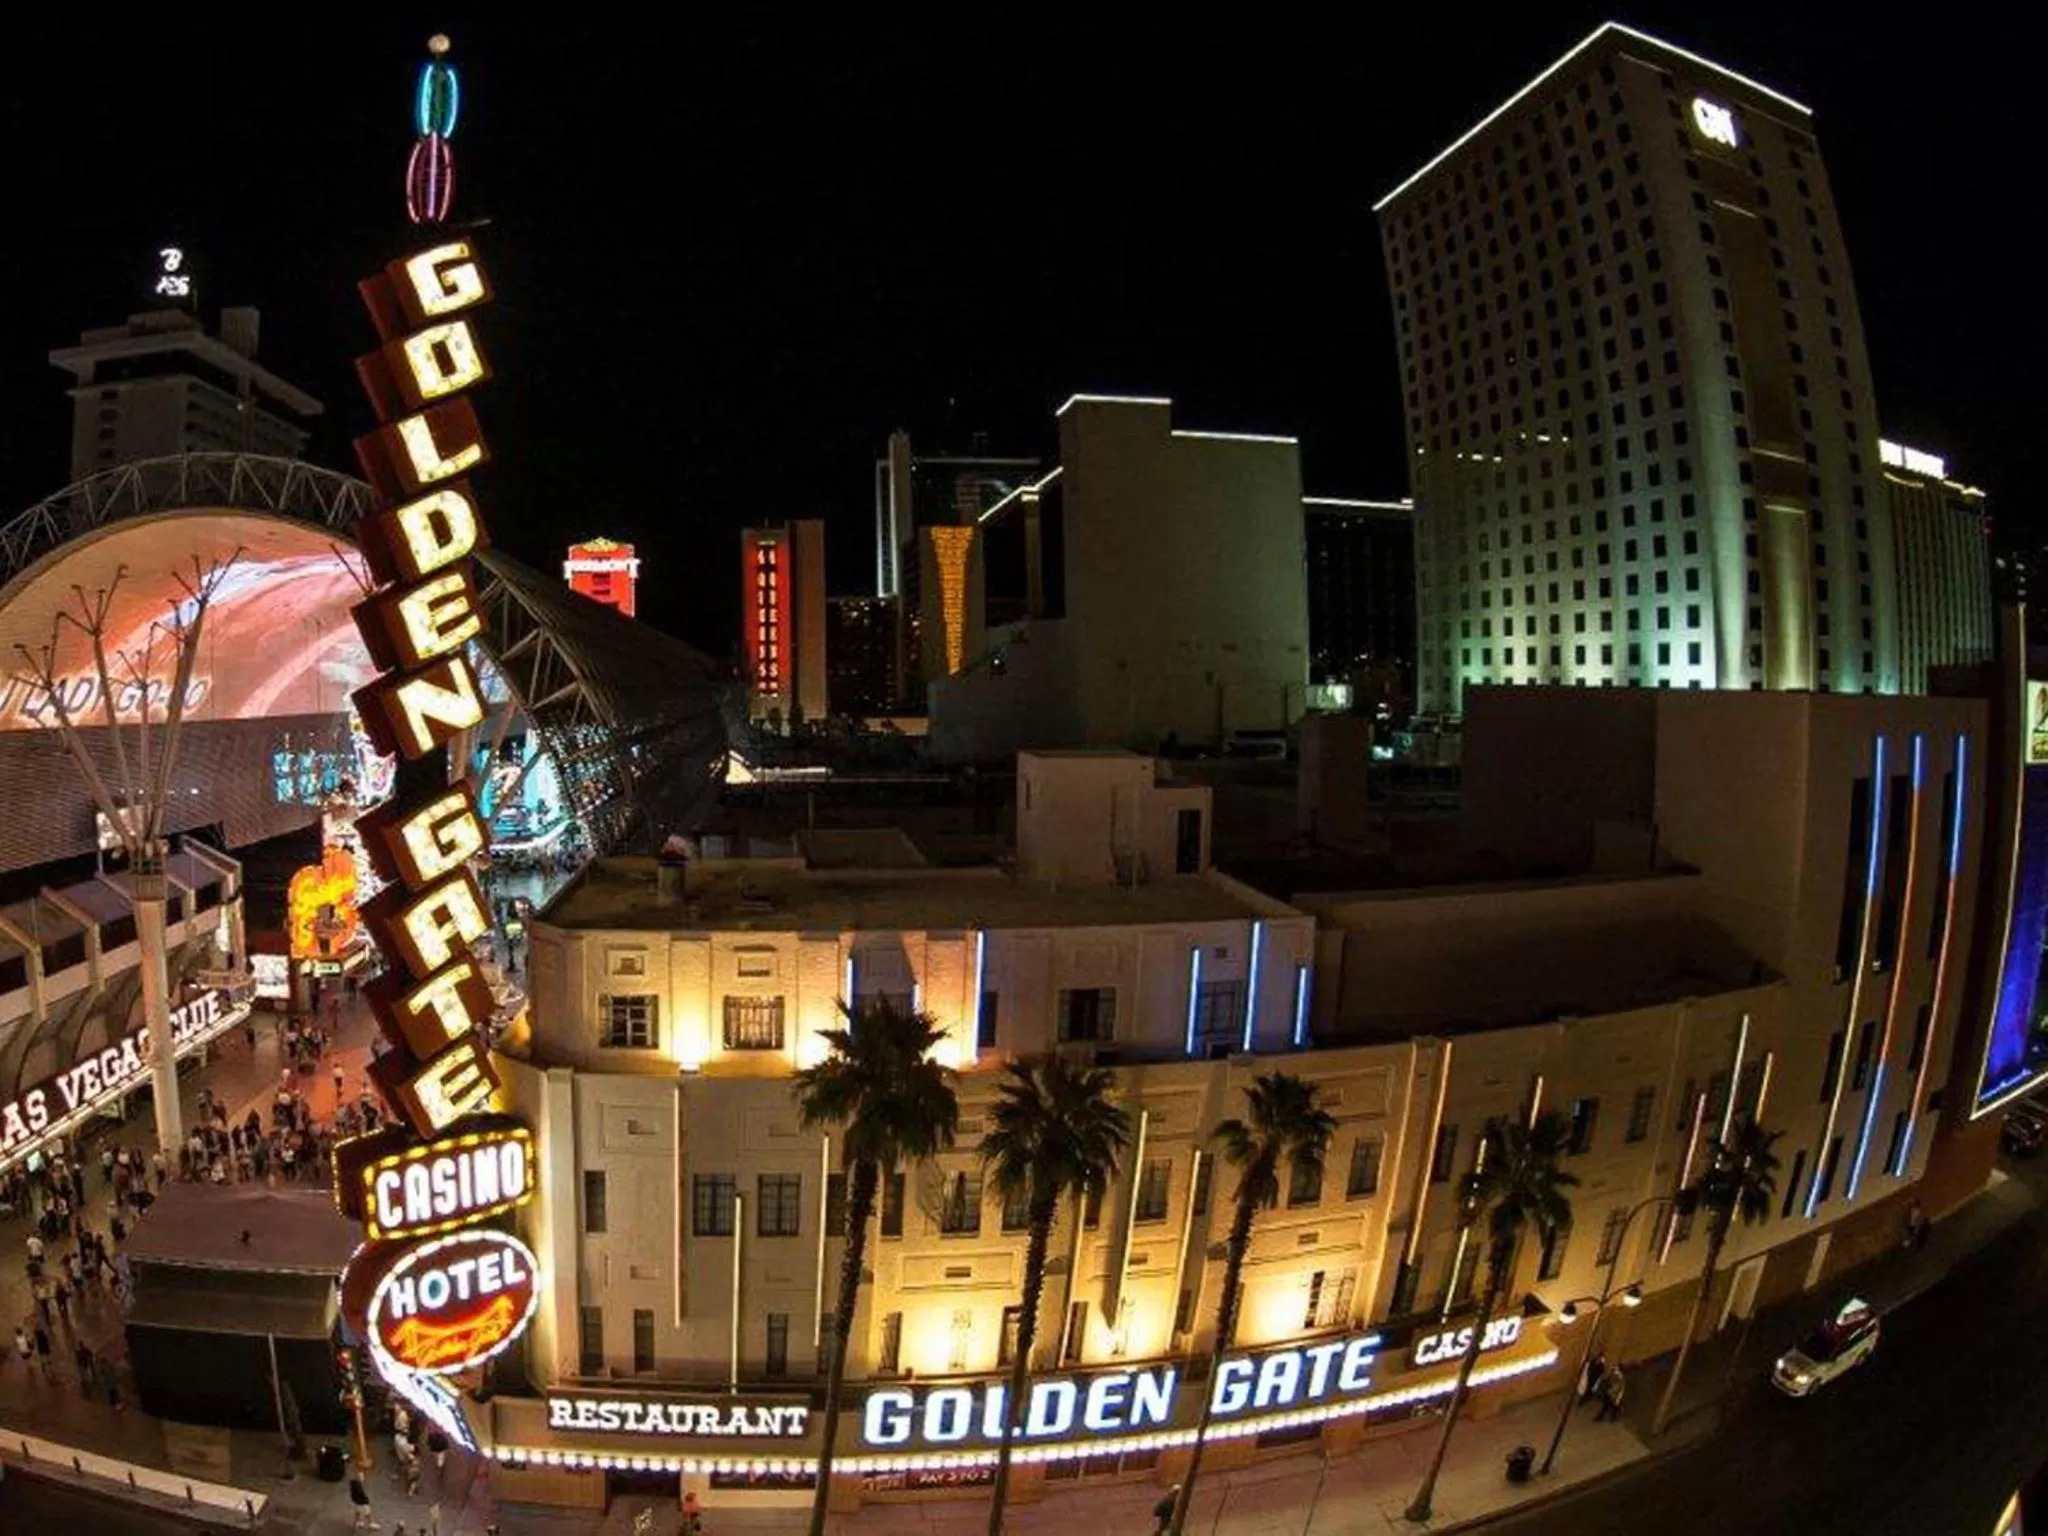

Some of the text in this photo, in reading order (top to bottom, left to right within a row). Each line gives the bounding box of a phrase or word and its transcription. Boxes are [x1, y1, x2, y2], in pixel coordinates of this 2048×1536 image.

[397, 242, 494, 1130] GOLDEN GATE
[0, 1090, 48, 1149] AS
[376, 1141, 525, 1228] CASINO
[389, 1247, 527, 1319] HOTEL
[1415, 1316, 1522, 1365] CASNO
[549, 1398, 809, 1435] RESTAURANT
[864, 1335, 1381, 1444] GOLDEN GATE
